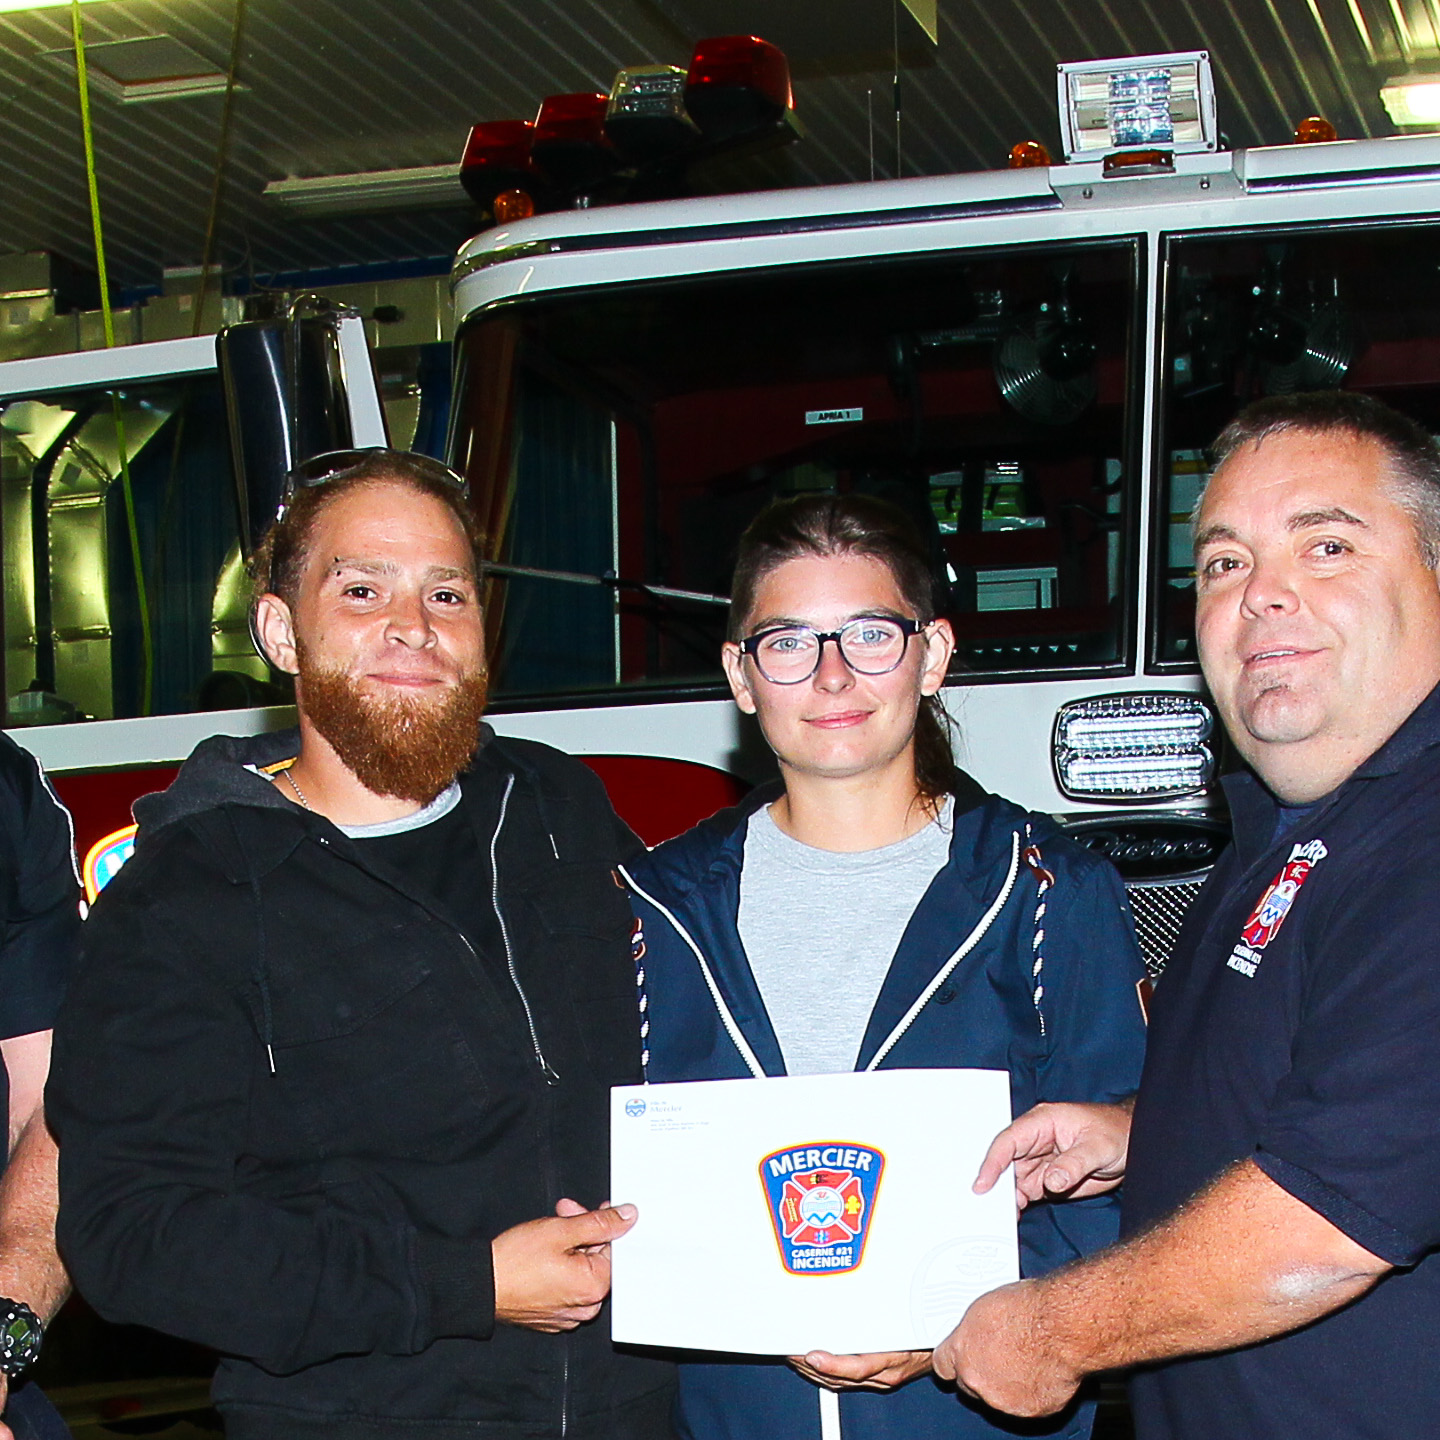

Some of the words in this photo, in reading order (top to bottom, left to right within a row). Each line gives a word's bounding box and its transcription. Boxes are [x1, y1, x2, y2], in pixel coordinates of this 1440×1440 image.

[768, 1148, 872, 1177] MERCIER
[791, 1248, 834, 1258] CASERNE
[836, 1247, 853, 1256] #21
[793, 1256, 853, 1269] INCENDIE
